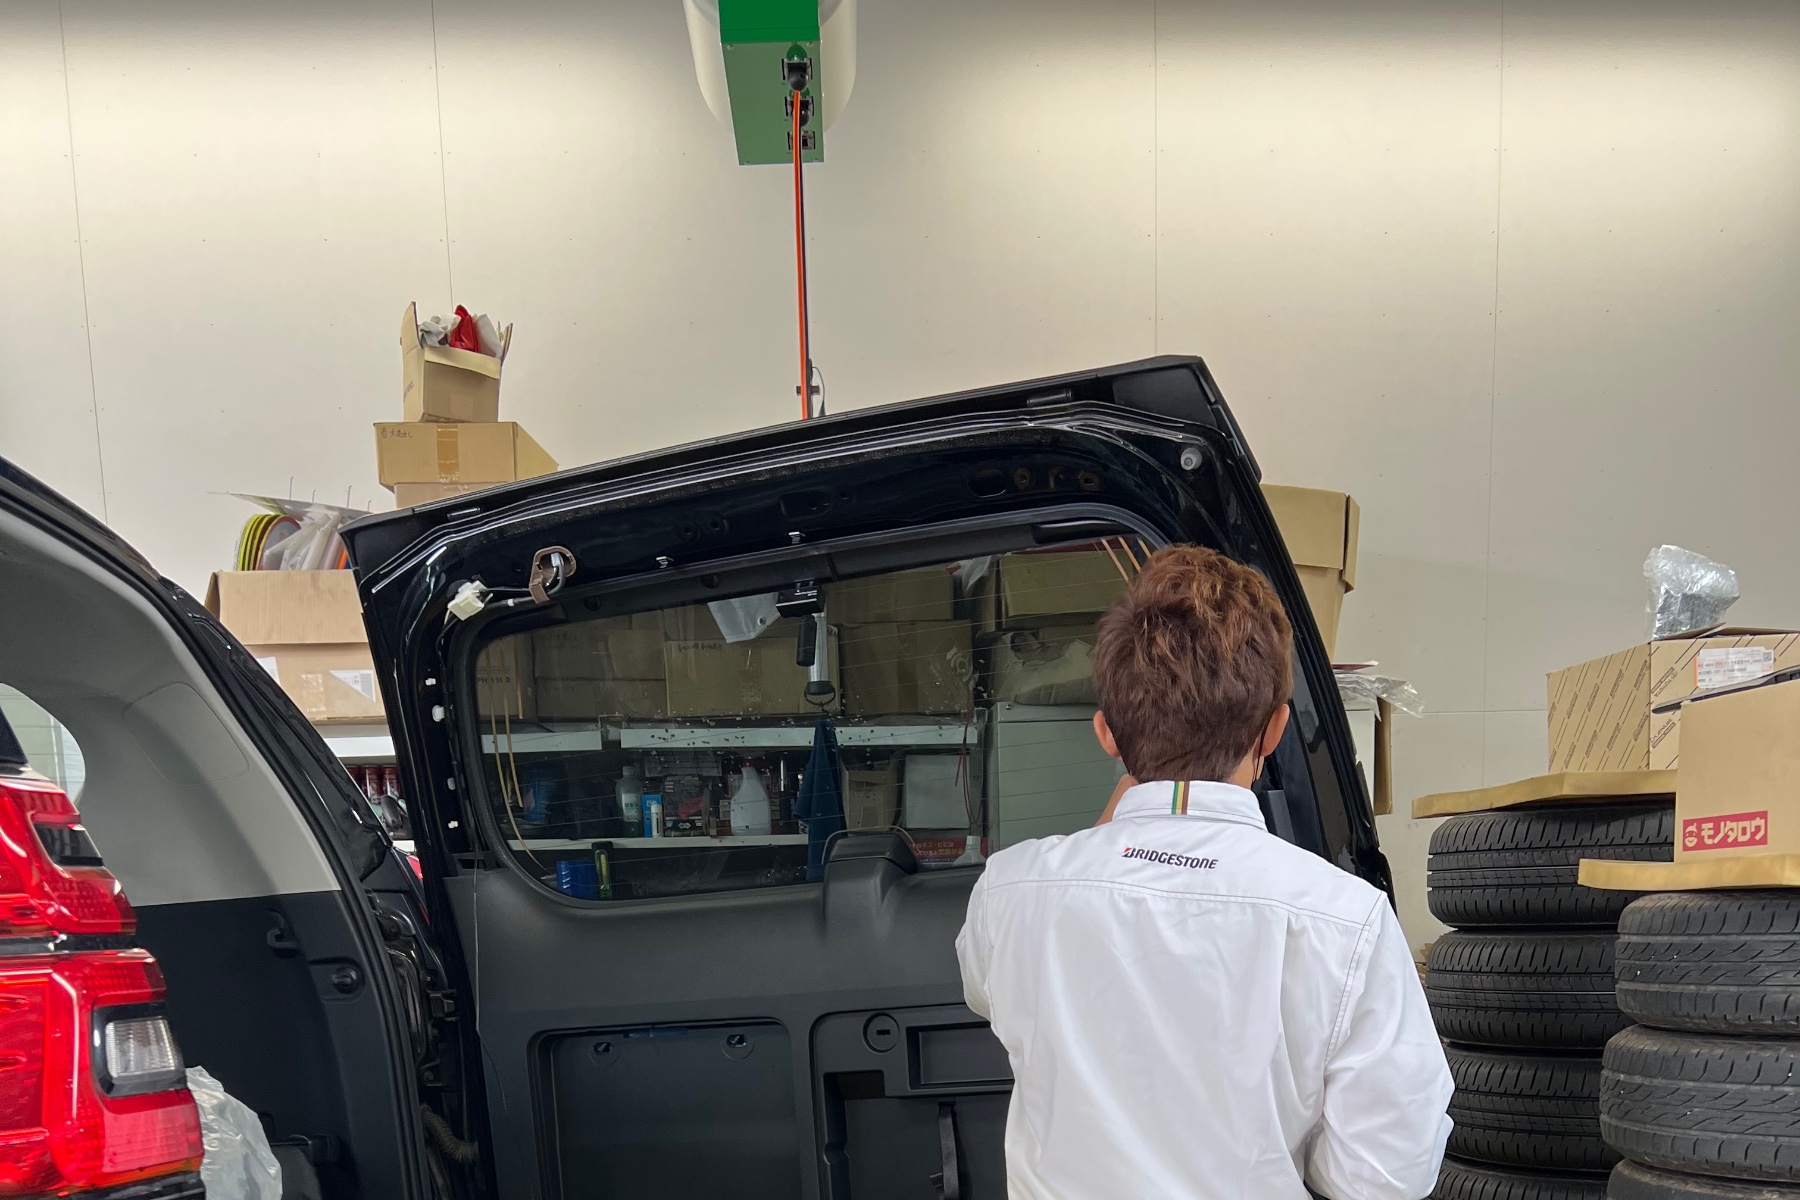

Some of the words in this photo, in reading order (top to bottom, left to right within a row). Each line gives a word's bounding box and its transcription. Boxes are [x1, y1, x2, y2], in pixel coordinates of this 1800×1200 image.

[1701, 817, 1765, 844] モノタロウ
[1122, 847, 1218, 869] BRIDGESTONE
